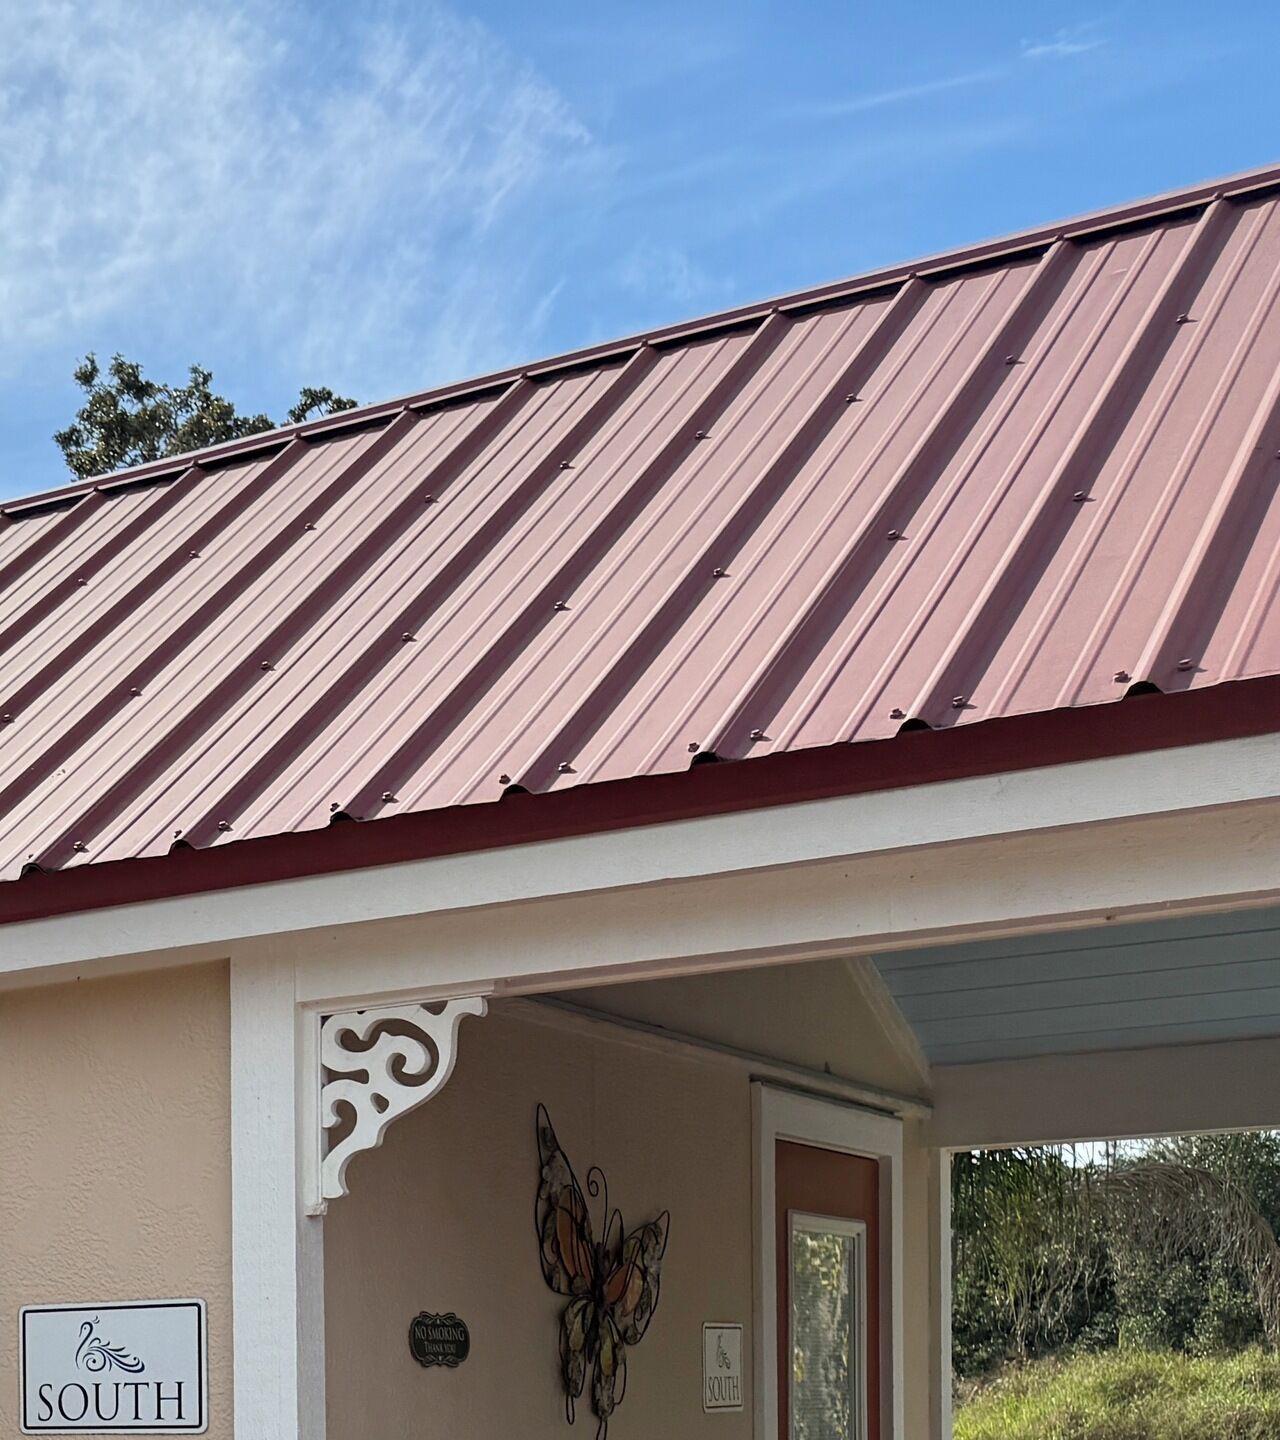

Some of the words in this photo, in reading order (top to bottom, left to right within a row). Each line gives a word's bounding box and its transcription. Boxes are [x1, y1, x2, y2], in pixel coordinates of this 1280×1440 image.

[414, 1326, 427, 1340] NO
[427, 1326, 465, 1341] SMOKING
[38, 1380, 186, 1422] SOUTH
[708, 1376, 740, 1402] SOUTH
